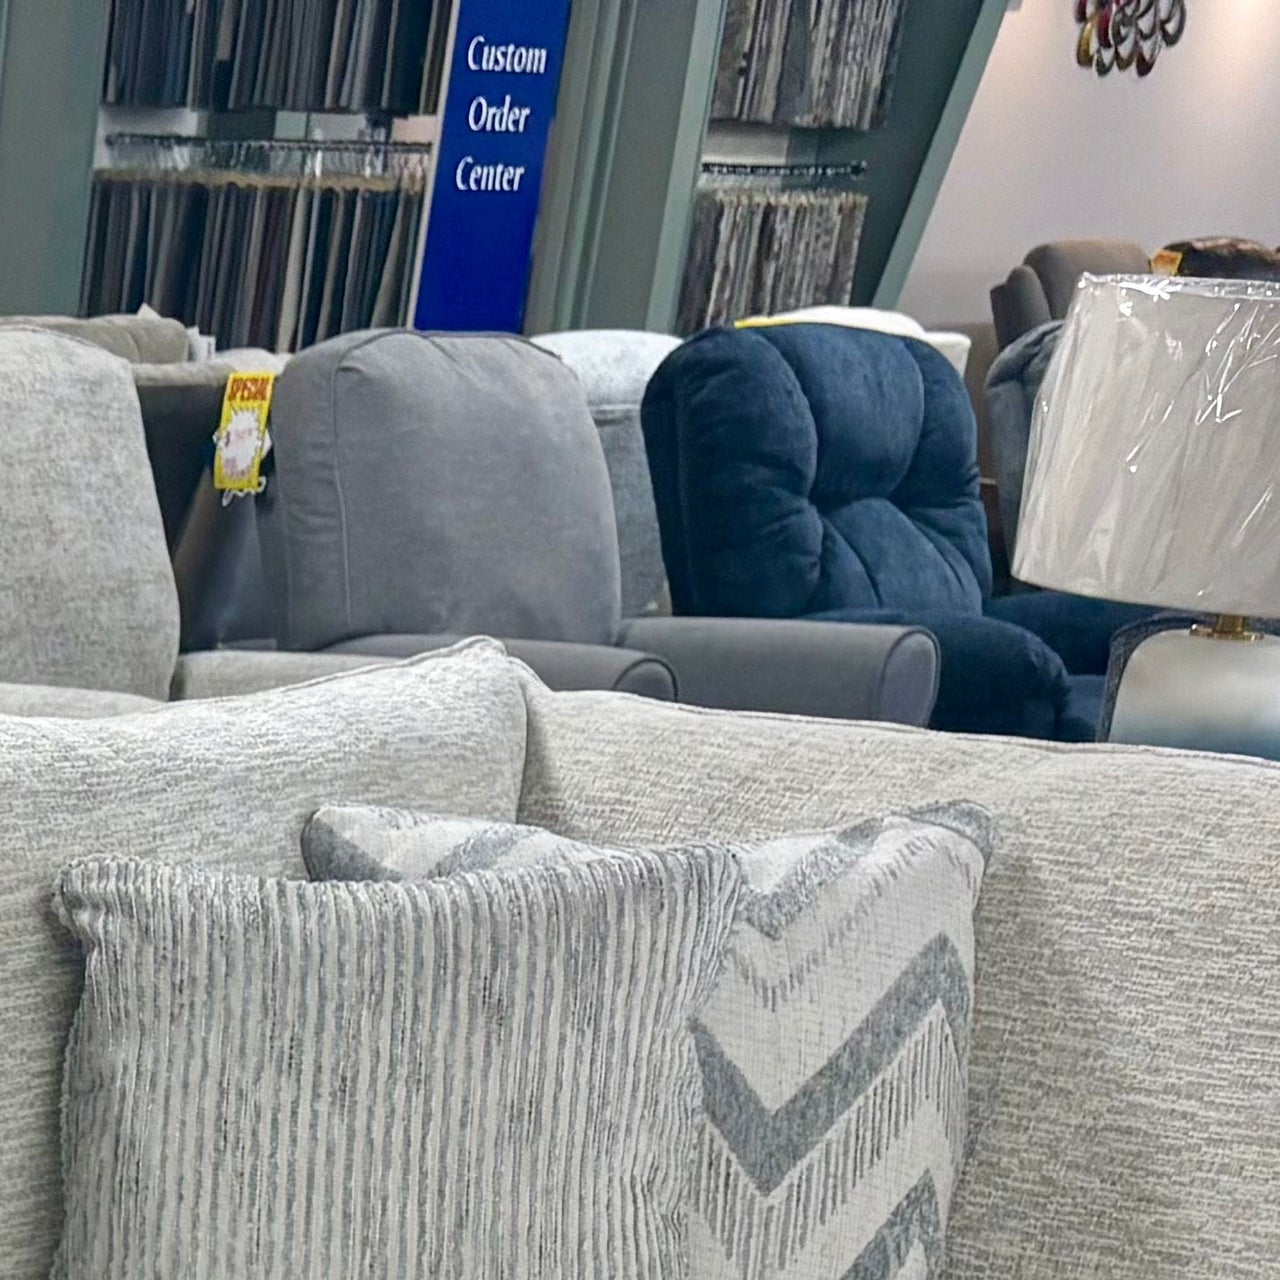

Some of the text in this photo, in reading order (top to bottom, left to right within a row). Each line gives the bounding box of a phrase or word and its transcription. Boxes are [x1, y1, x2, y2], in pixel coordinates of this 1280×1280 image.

[468, 35, 547, 74] Custom
[468, 94, 531, 133] Order
[455, 155, 525, 191] Center
[228, 377, 270, 401] SPECIAL
